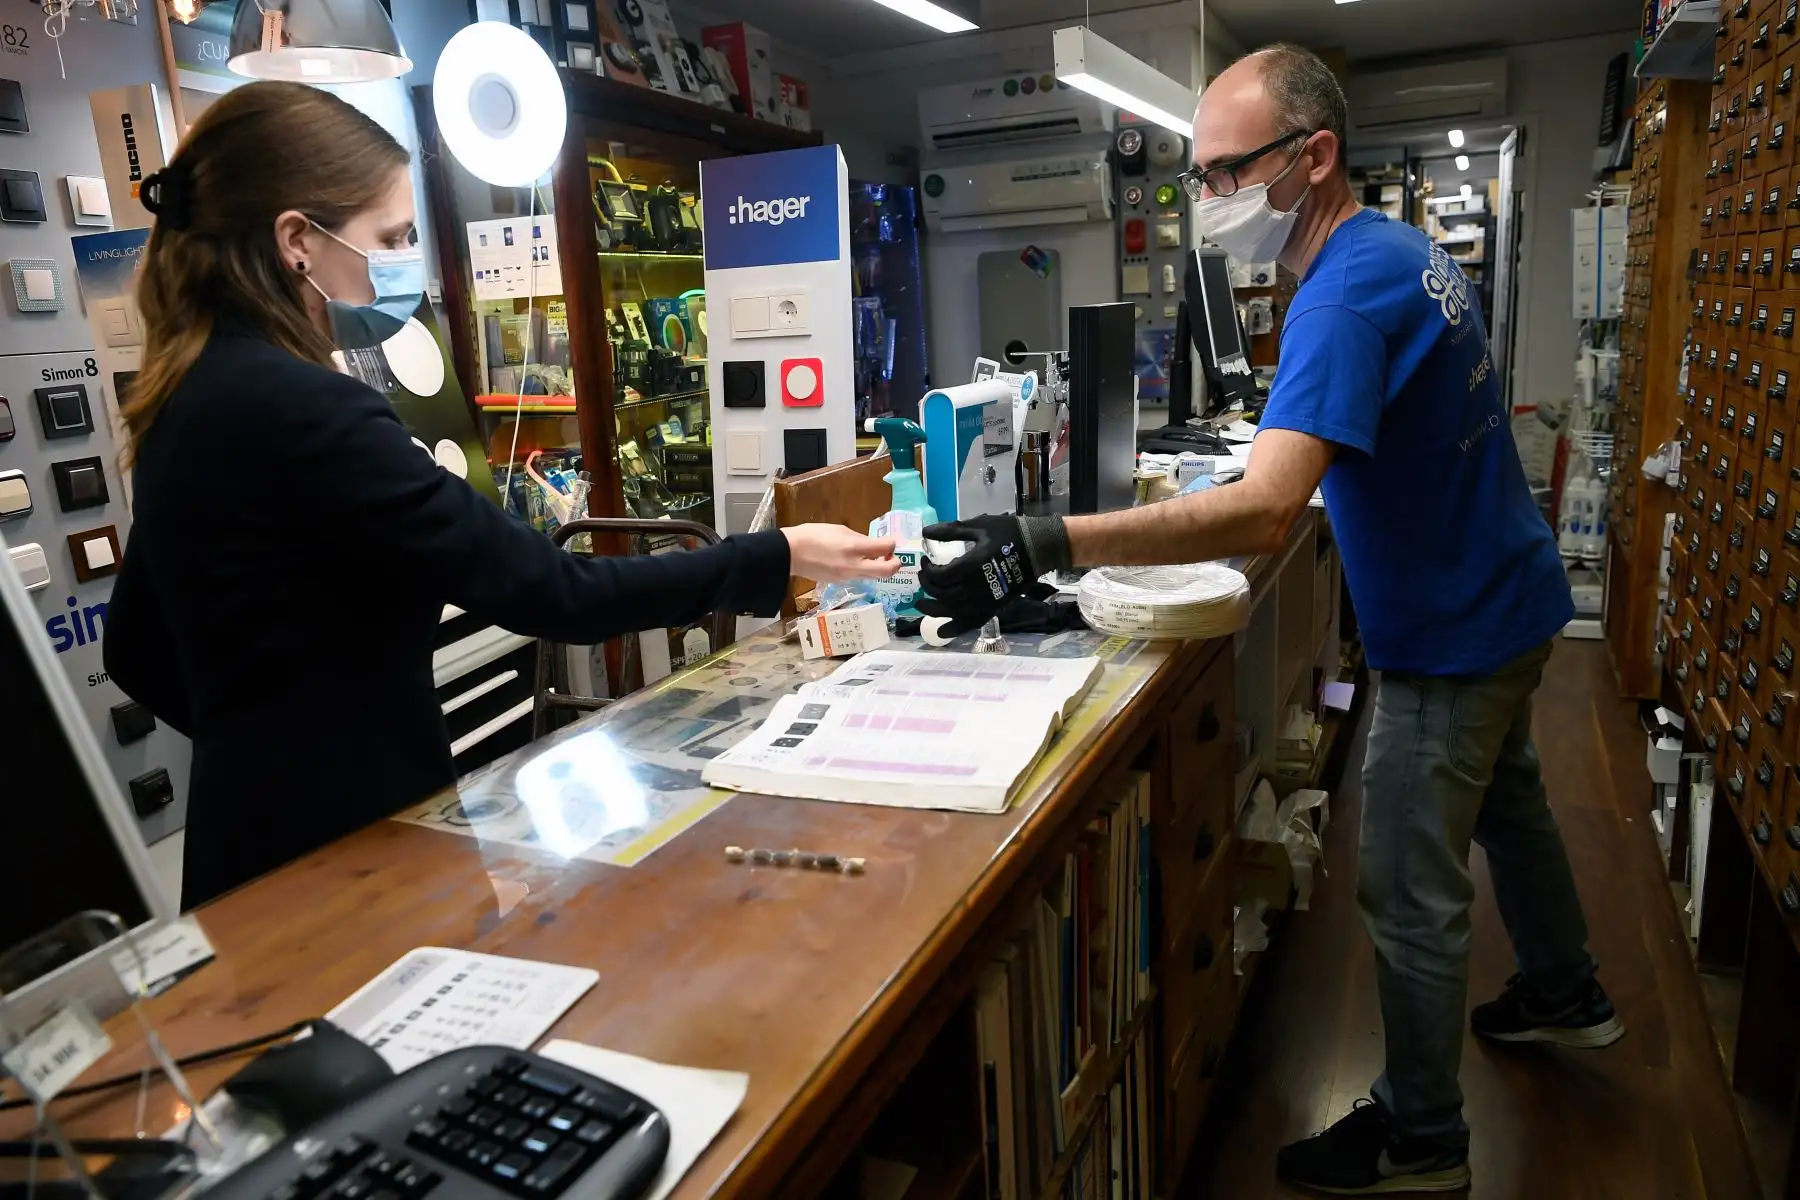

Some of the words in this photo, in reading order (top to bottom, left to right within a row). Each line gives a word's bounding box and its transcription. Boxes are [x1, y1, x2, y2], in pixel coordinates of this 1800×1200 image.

[3, 24, 29, 48] 82
[41, 368, 84, 382] Simon
[84, 358, 98, 376] 8
